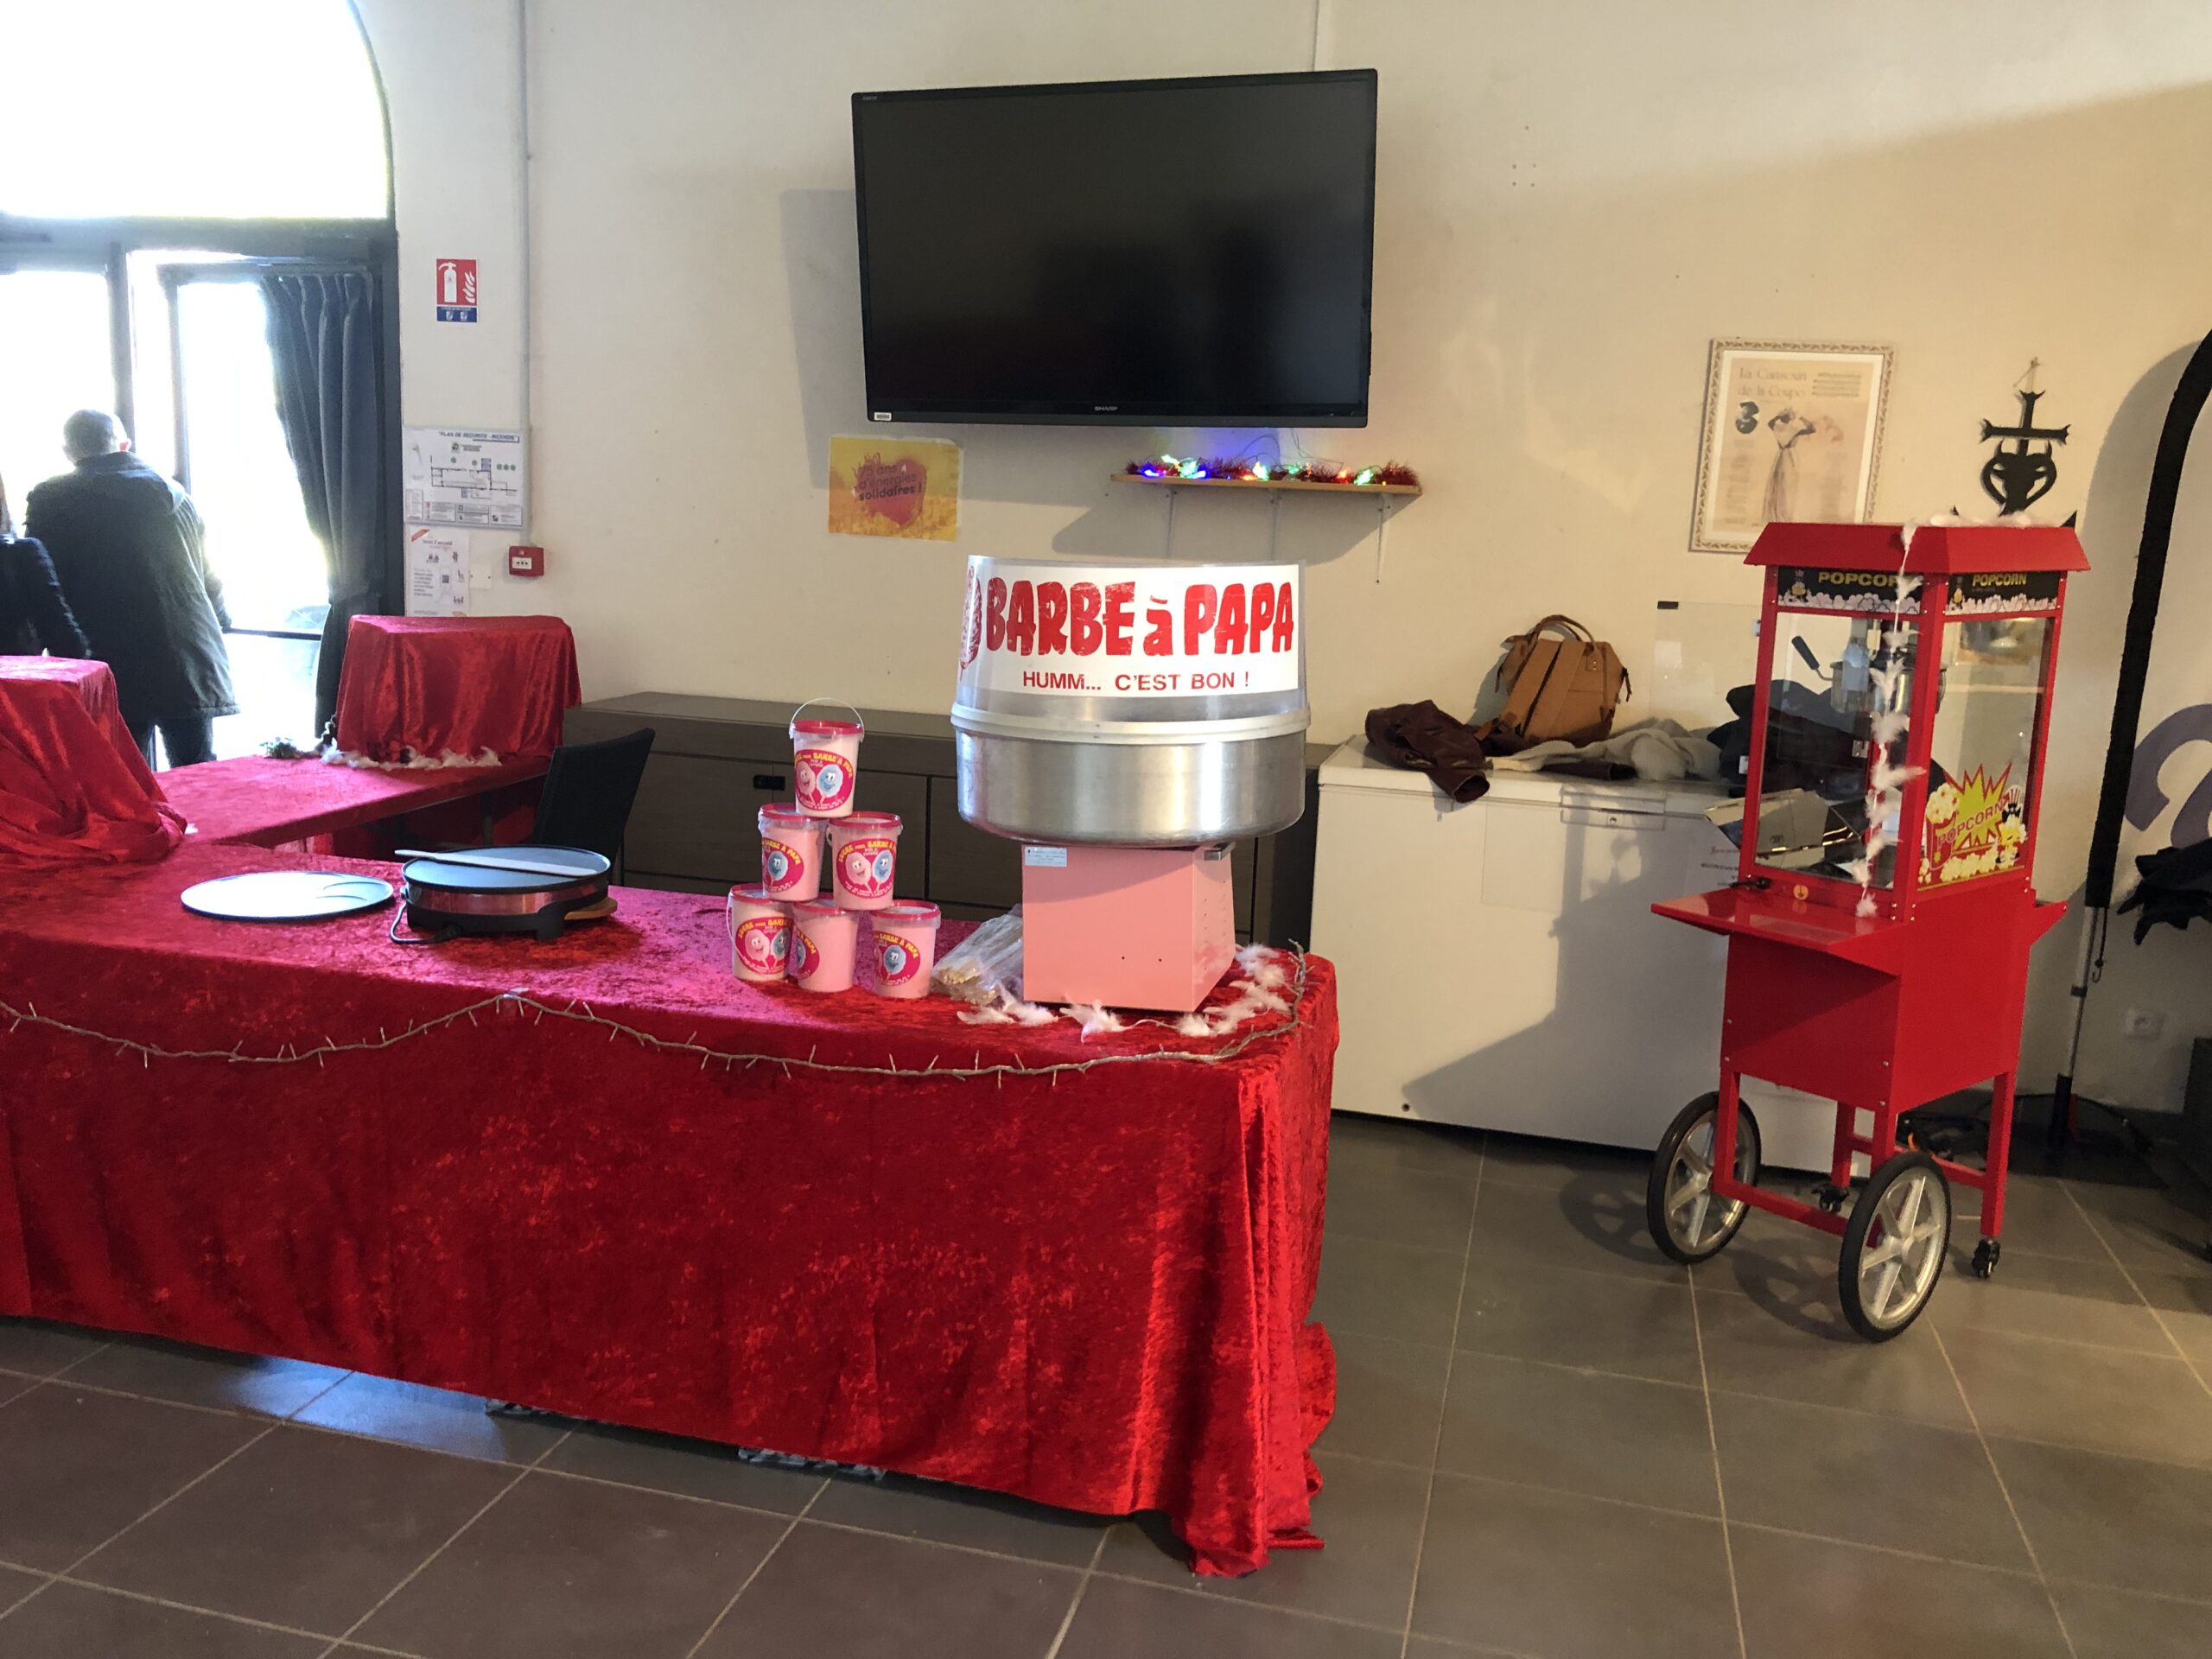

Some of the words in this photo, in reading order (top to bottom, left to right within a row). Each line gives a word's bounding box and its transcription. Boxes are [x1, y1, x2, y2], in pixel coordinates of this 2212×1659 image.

[859, 485, 914, 501] solidaires
[1972, 573, 2027, 587] POPCORN
[986, 576, 1135, 657] BARBE
[1142, 594, 1174, 657] à
[1184, 582, 1294, 657] PAPA
[1022, 671, 1102, 691] HUMM...
[1115, 673, 1181, 691] C'EST
[1191, 671, 1236, 690] BON
[1938, 797, 2005, 846] POPCORN
